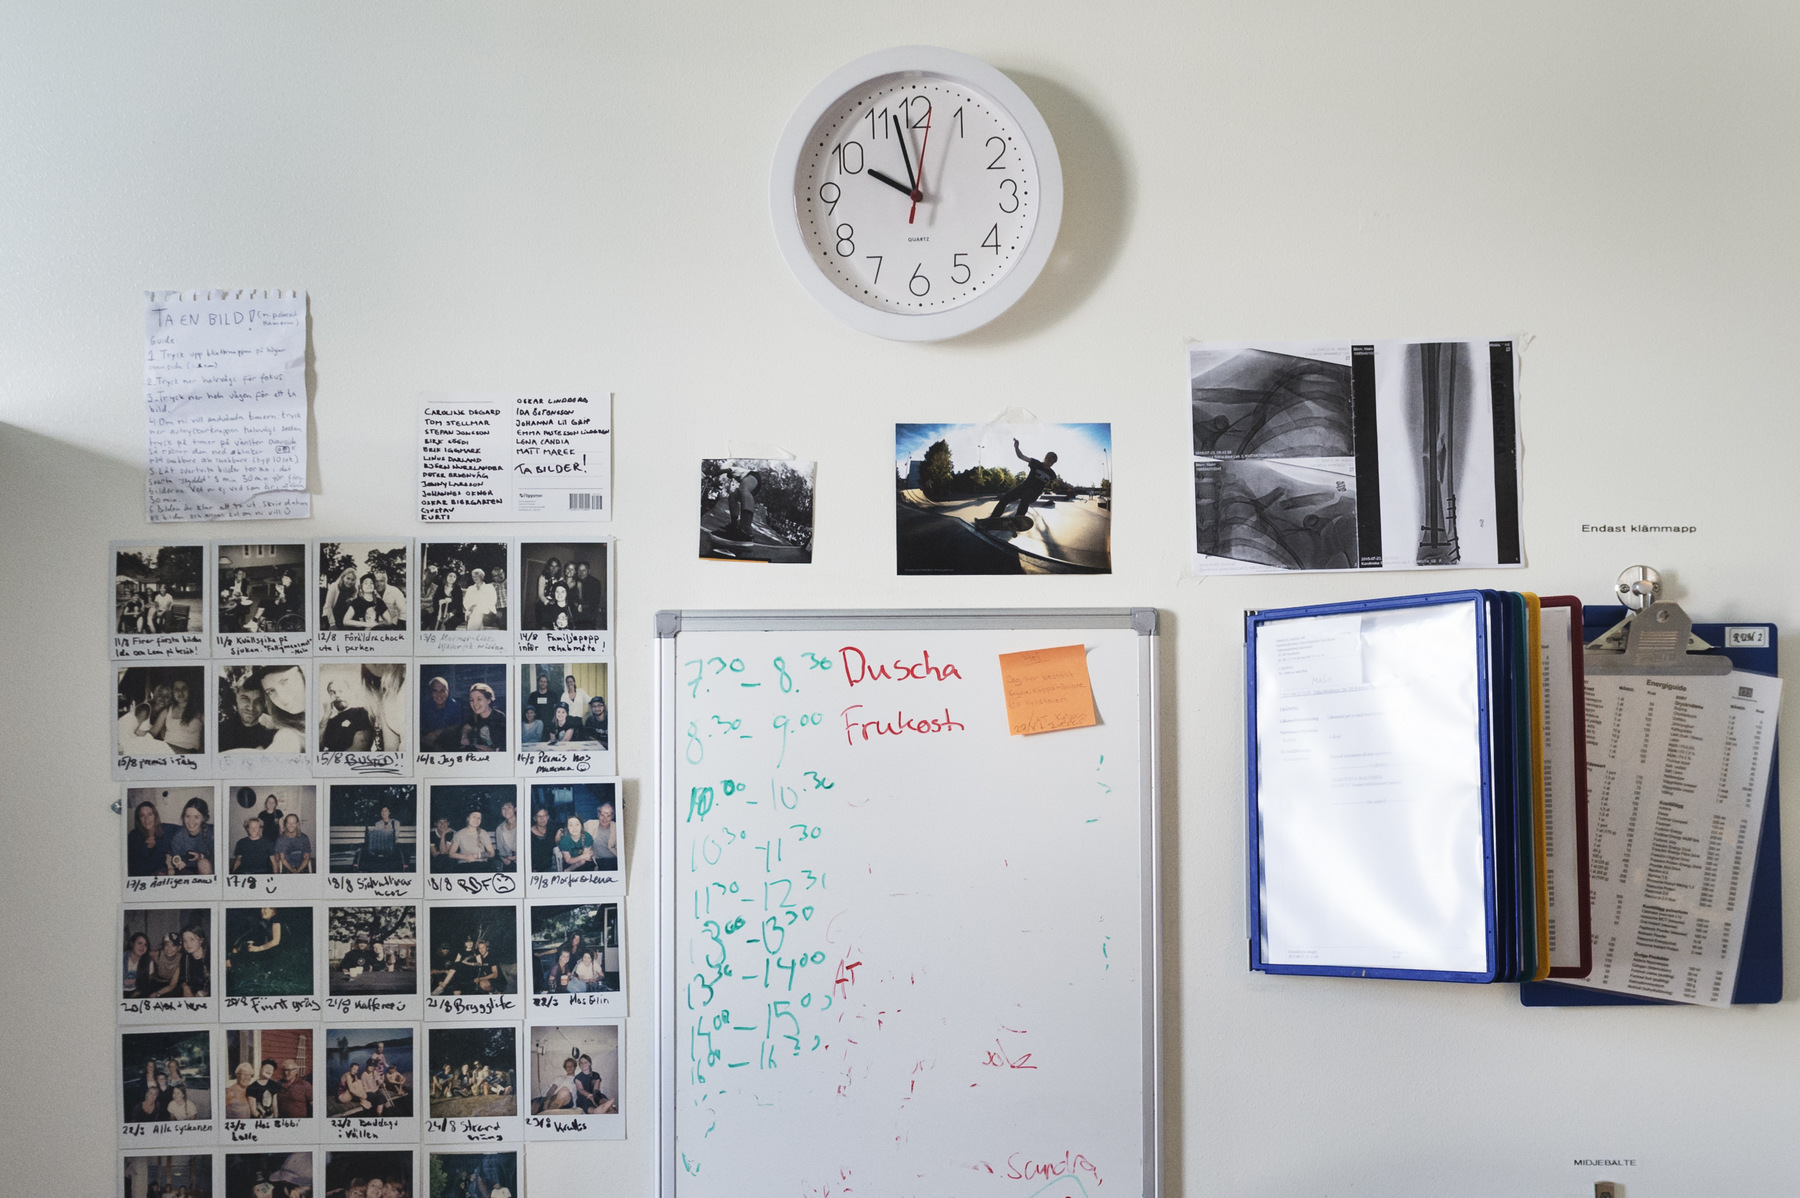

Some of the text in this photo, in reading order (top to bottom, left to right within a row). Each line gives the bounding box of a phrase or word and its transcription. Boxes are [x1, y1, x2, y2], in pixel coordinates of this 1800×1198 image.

[865, 107, 888, 139] 11
[899, 96, 931, 128] 12
[954, 106, 963, 138] 1
[832, 141, 864, 174] 10
[986, 136, 1006, 169] 2
[820, 182, 841, 216] 9
[999, 179, 1019, 213] 3
[836, 223, 855, 257] 8
[981, 223, 1001, 255] 4
[866, 255, 883, 284] 7
[909, 263, 930, 296] 6
[951, 253, 971, 284] 5
[152, 308, 173, 327] TA
[180, 313, 199, 325] EN
[516, 408, 530, 416] IDA
[516, 419, 553, 427] JOHANNA
[1582, 524, 1697, 533] Endast klämmapp
[318, 632, 336, 643] 12/8
[520, 632, 538, 641] 14/8
[1758, 633, 1763, 641] 2
[839, 646, 962, 687] Duscha
[1646, 679, 1687, 692] Energiguide
[840, 704, 965, 746] Frukost
[316, 753, 343, 765] 15/8
[530, 875, 548, 889] 19/8
[425, 1118, 455, 1132] 24/8
